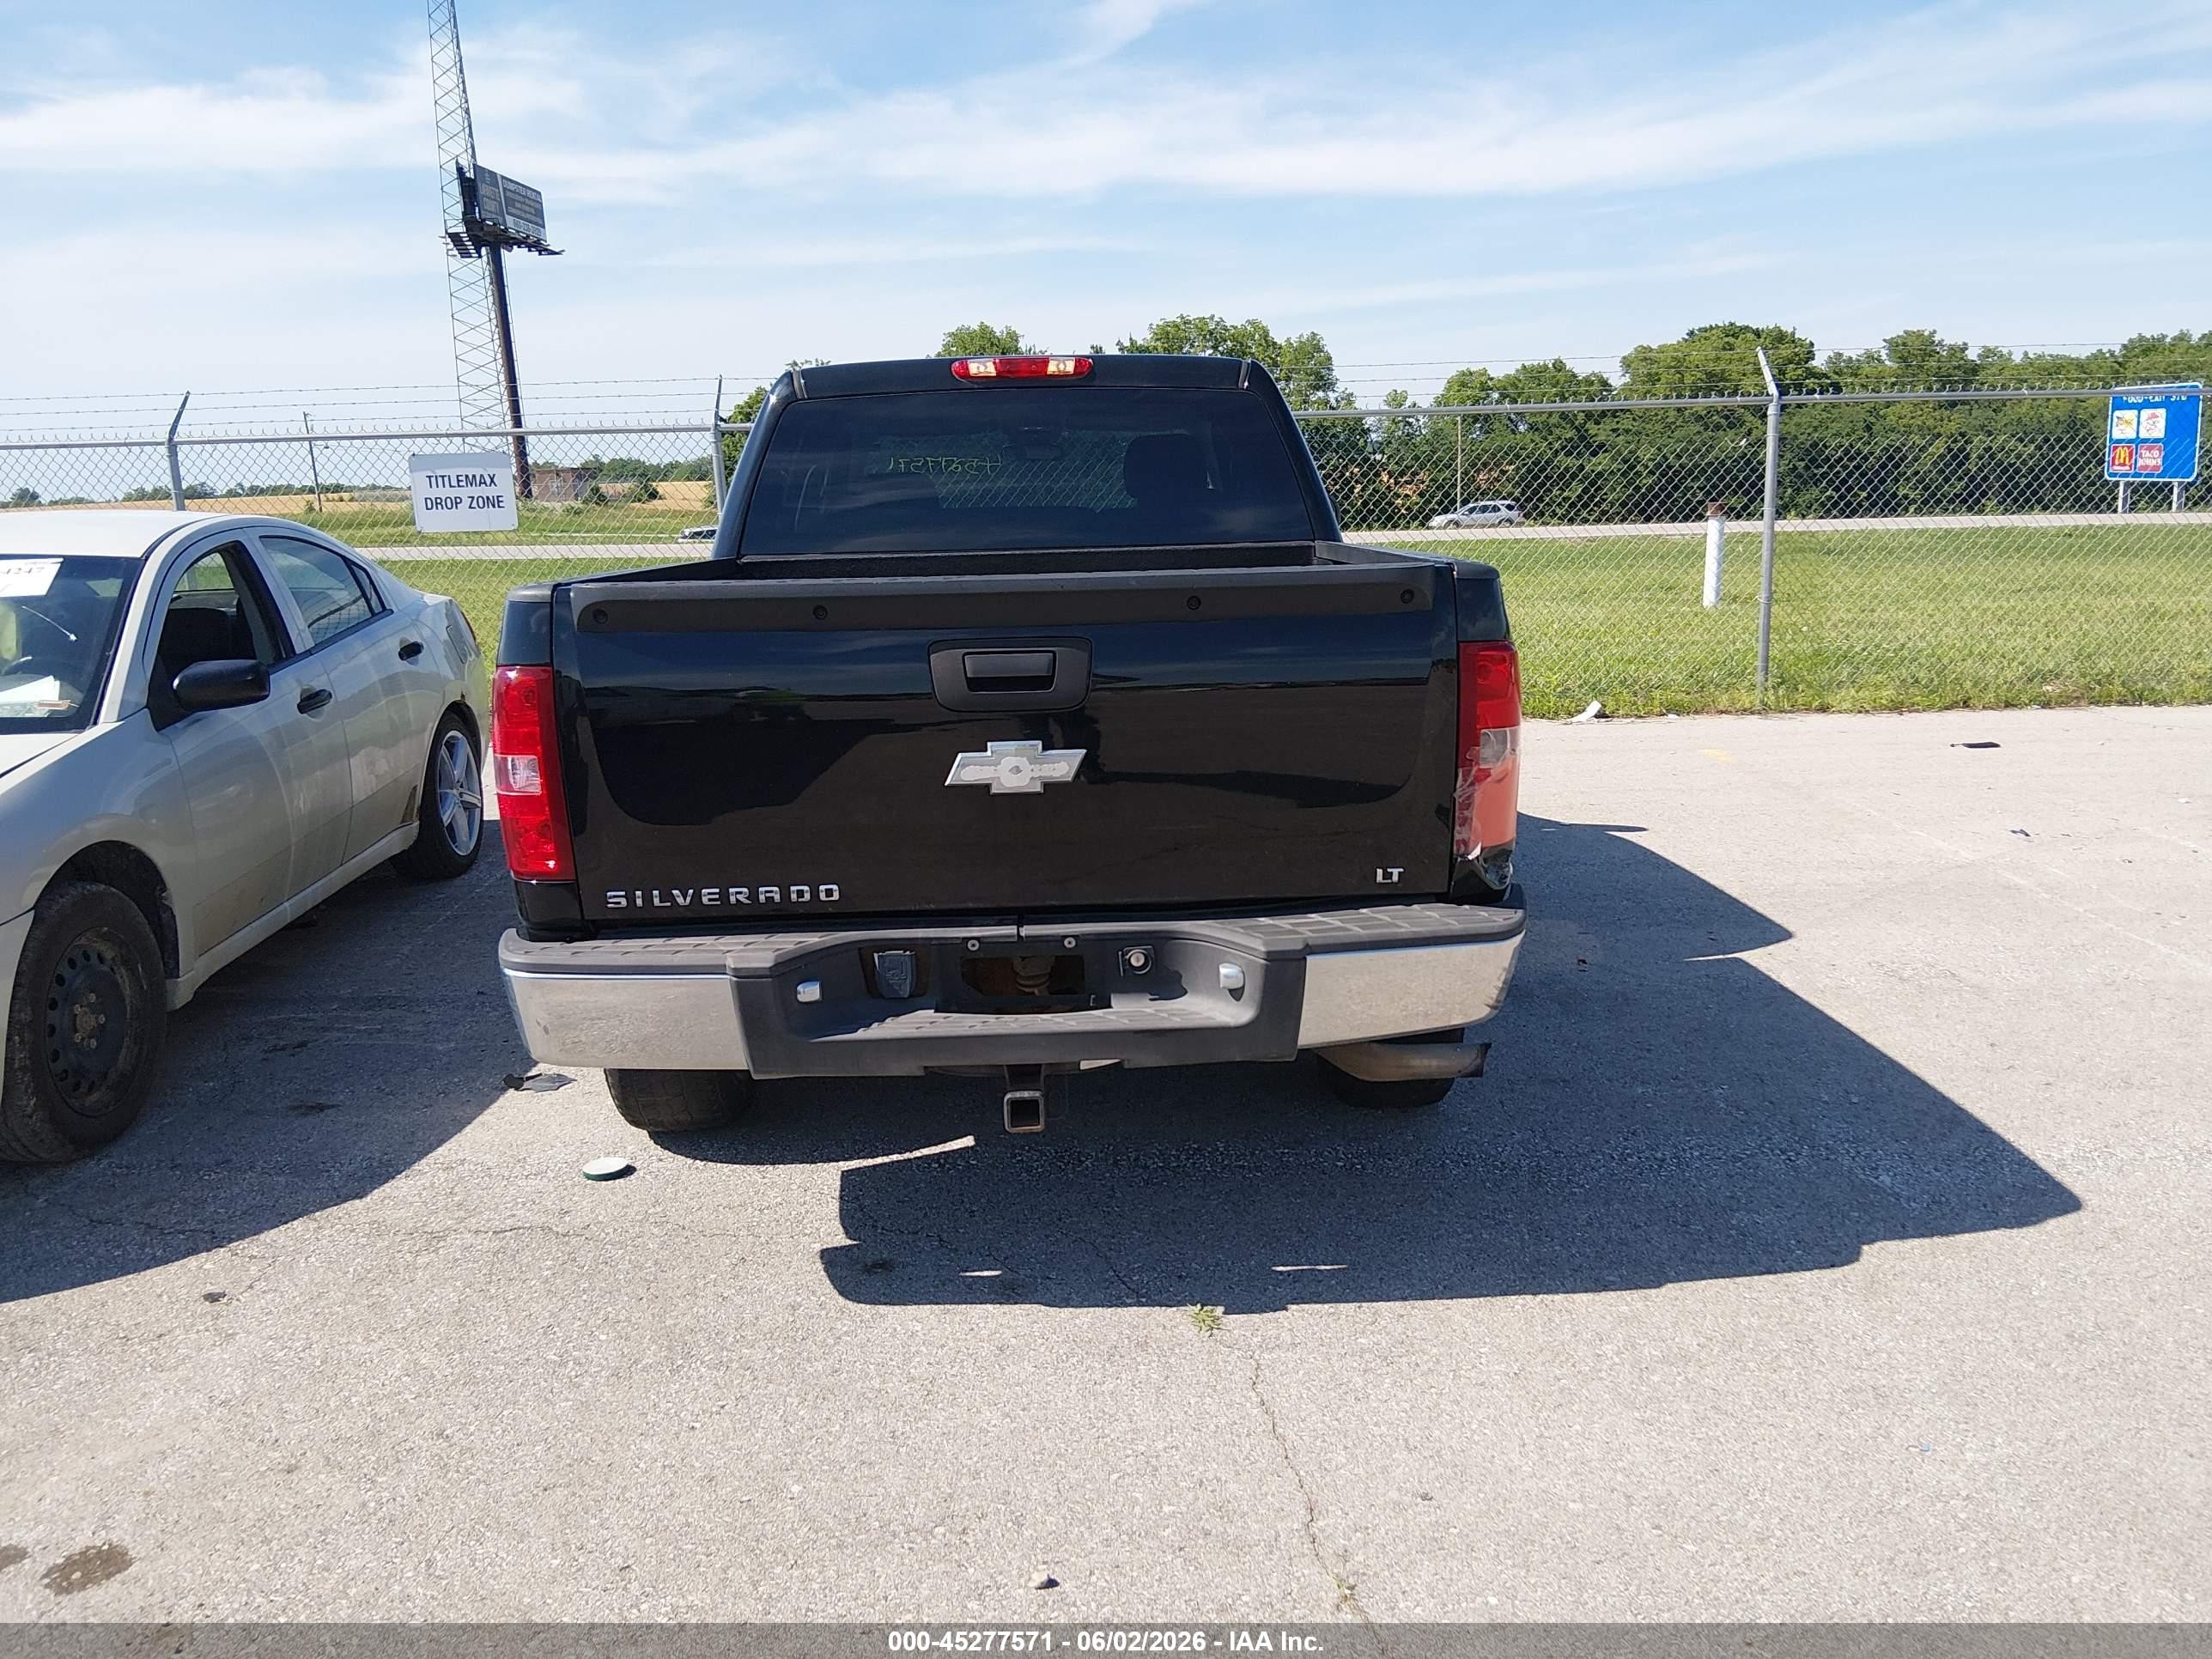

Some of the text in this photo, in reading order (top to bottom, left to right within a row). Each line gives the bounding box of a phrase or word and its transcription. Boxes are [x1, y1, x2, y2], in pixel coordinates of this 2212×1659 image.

[425, 473, 498, 489] TITLEMAX
[424, 495, 506, 511] DROP ZONE
[1376, 867, 1405, 883] LT
[606, 884, 841, 908] SILVERADO
